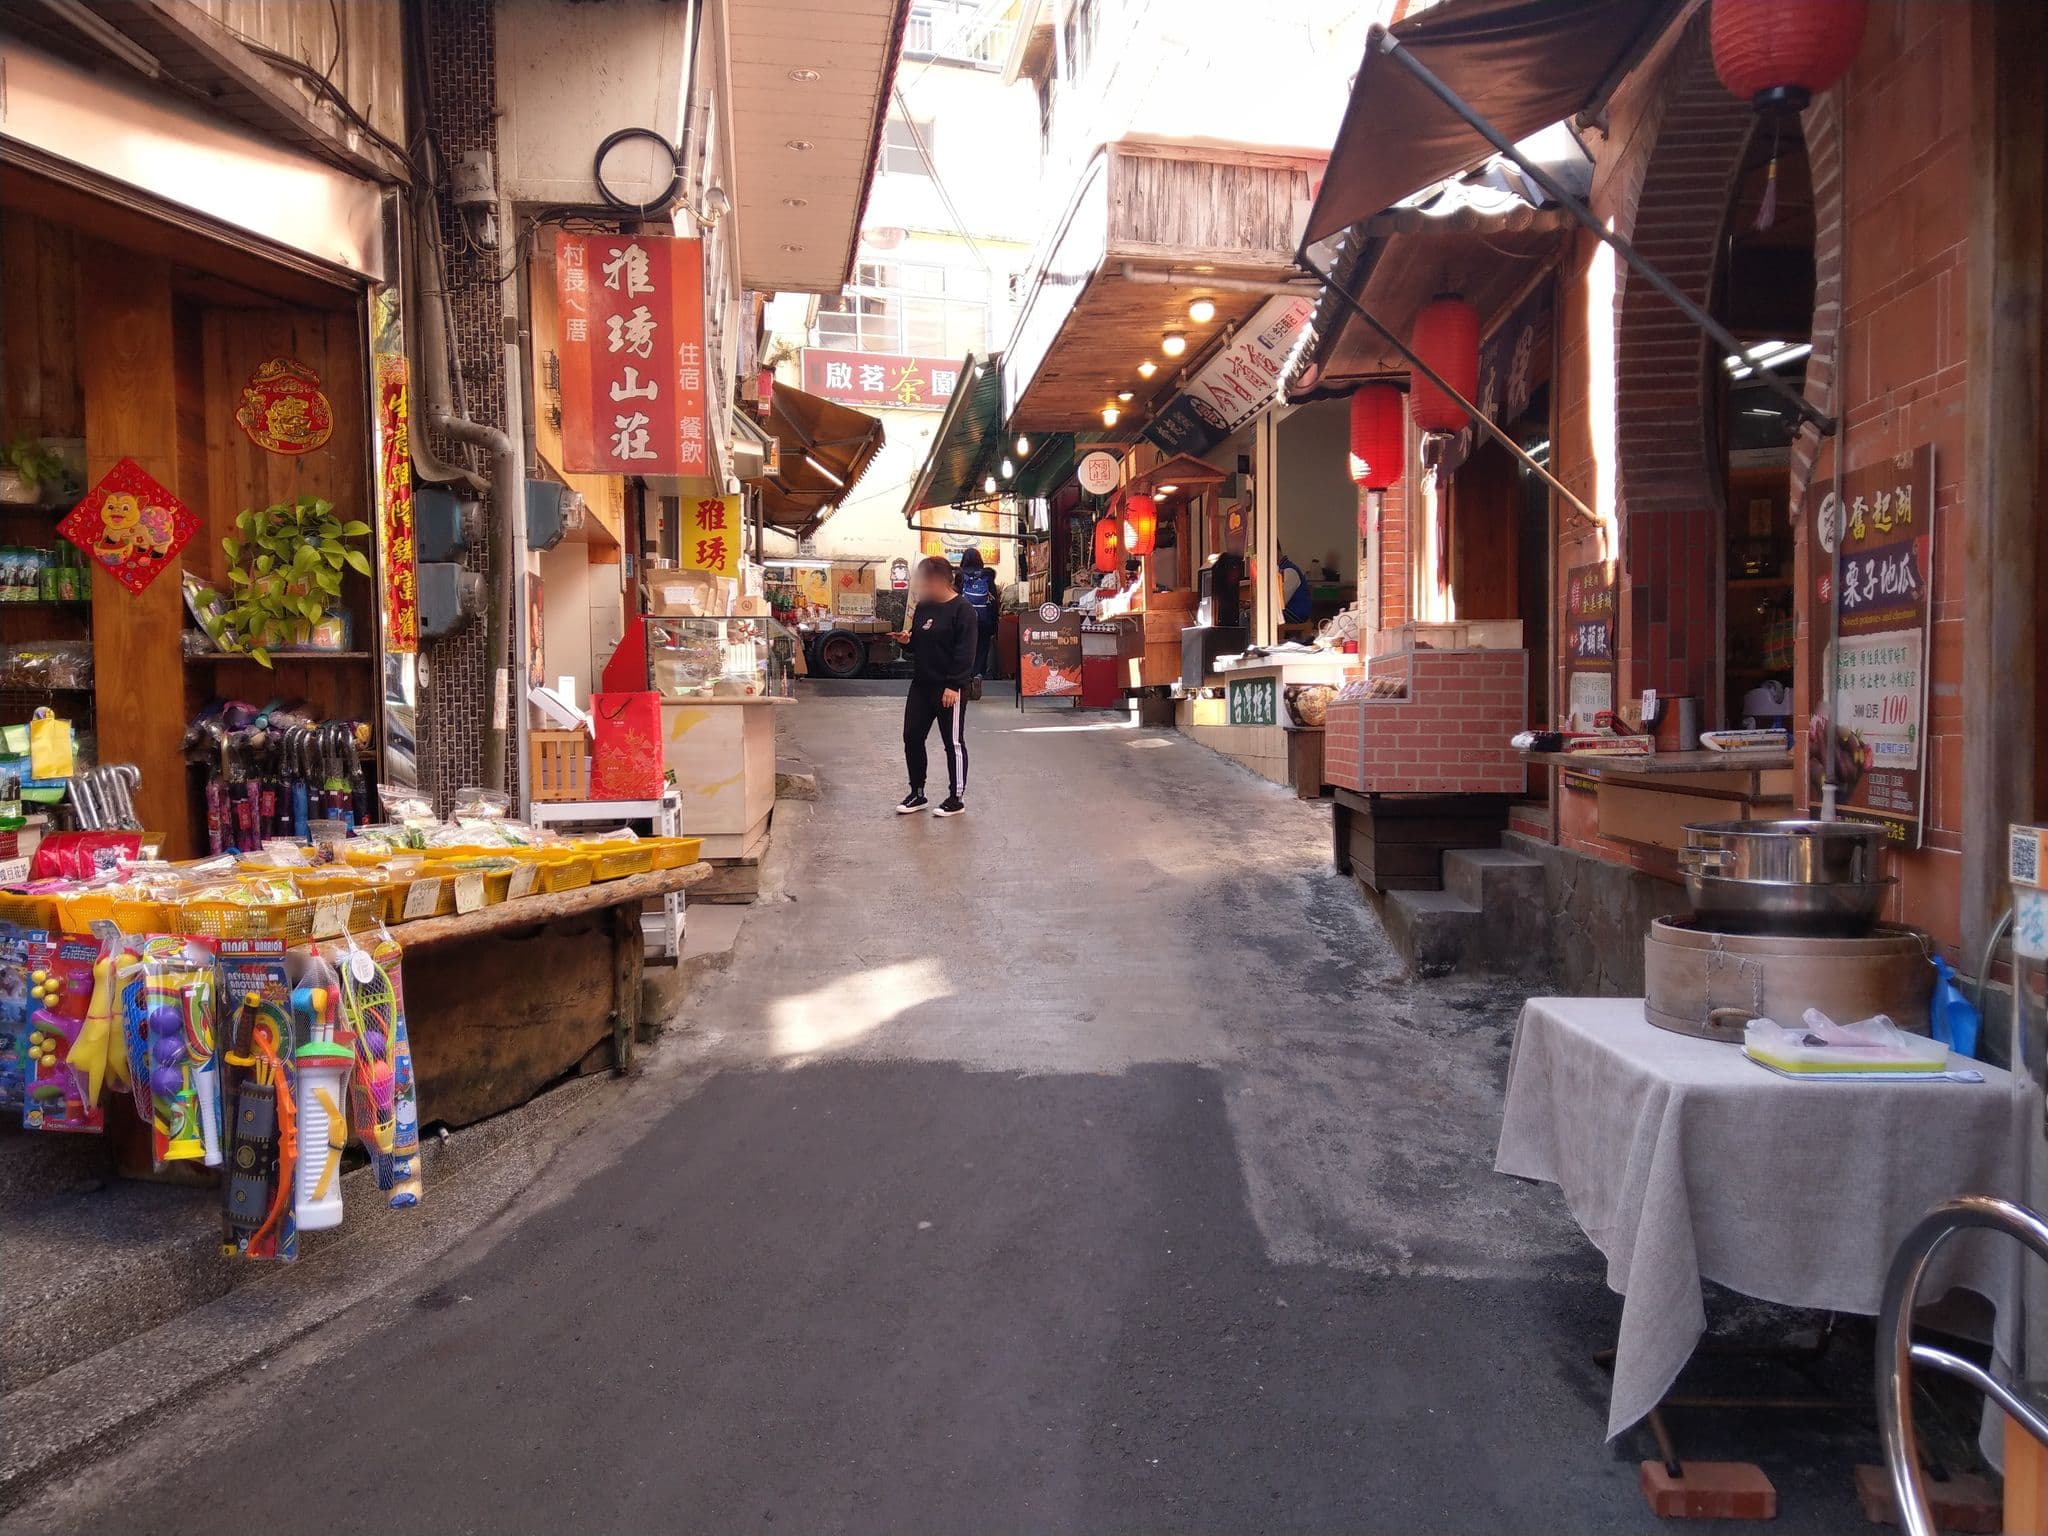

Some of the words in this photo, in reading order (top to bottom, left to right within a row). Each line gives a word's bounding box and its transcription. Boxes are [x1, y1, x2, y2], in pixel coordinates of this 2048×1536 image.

[602, 243, 658, 461] 雅琇山莊
[695, 497, 729, 572] 雅琇
[1849, 484, 1913, 541] 奮起湖
[1843, 553, 1916, 608] 栗子地瓜
[1881, 694, 1908, 725] 100
[221, 941, 248, 952] NINJA
[254, 941, 283, 952] WARRIOR
